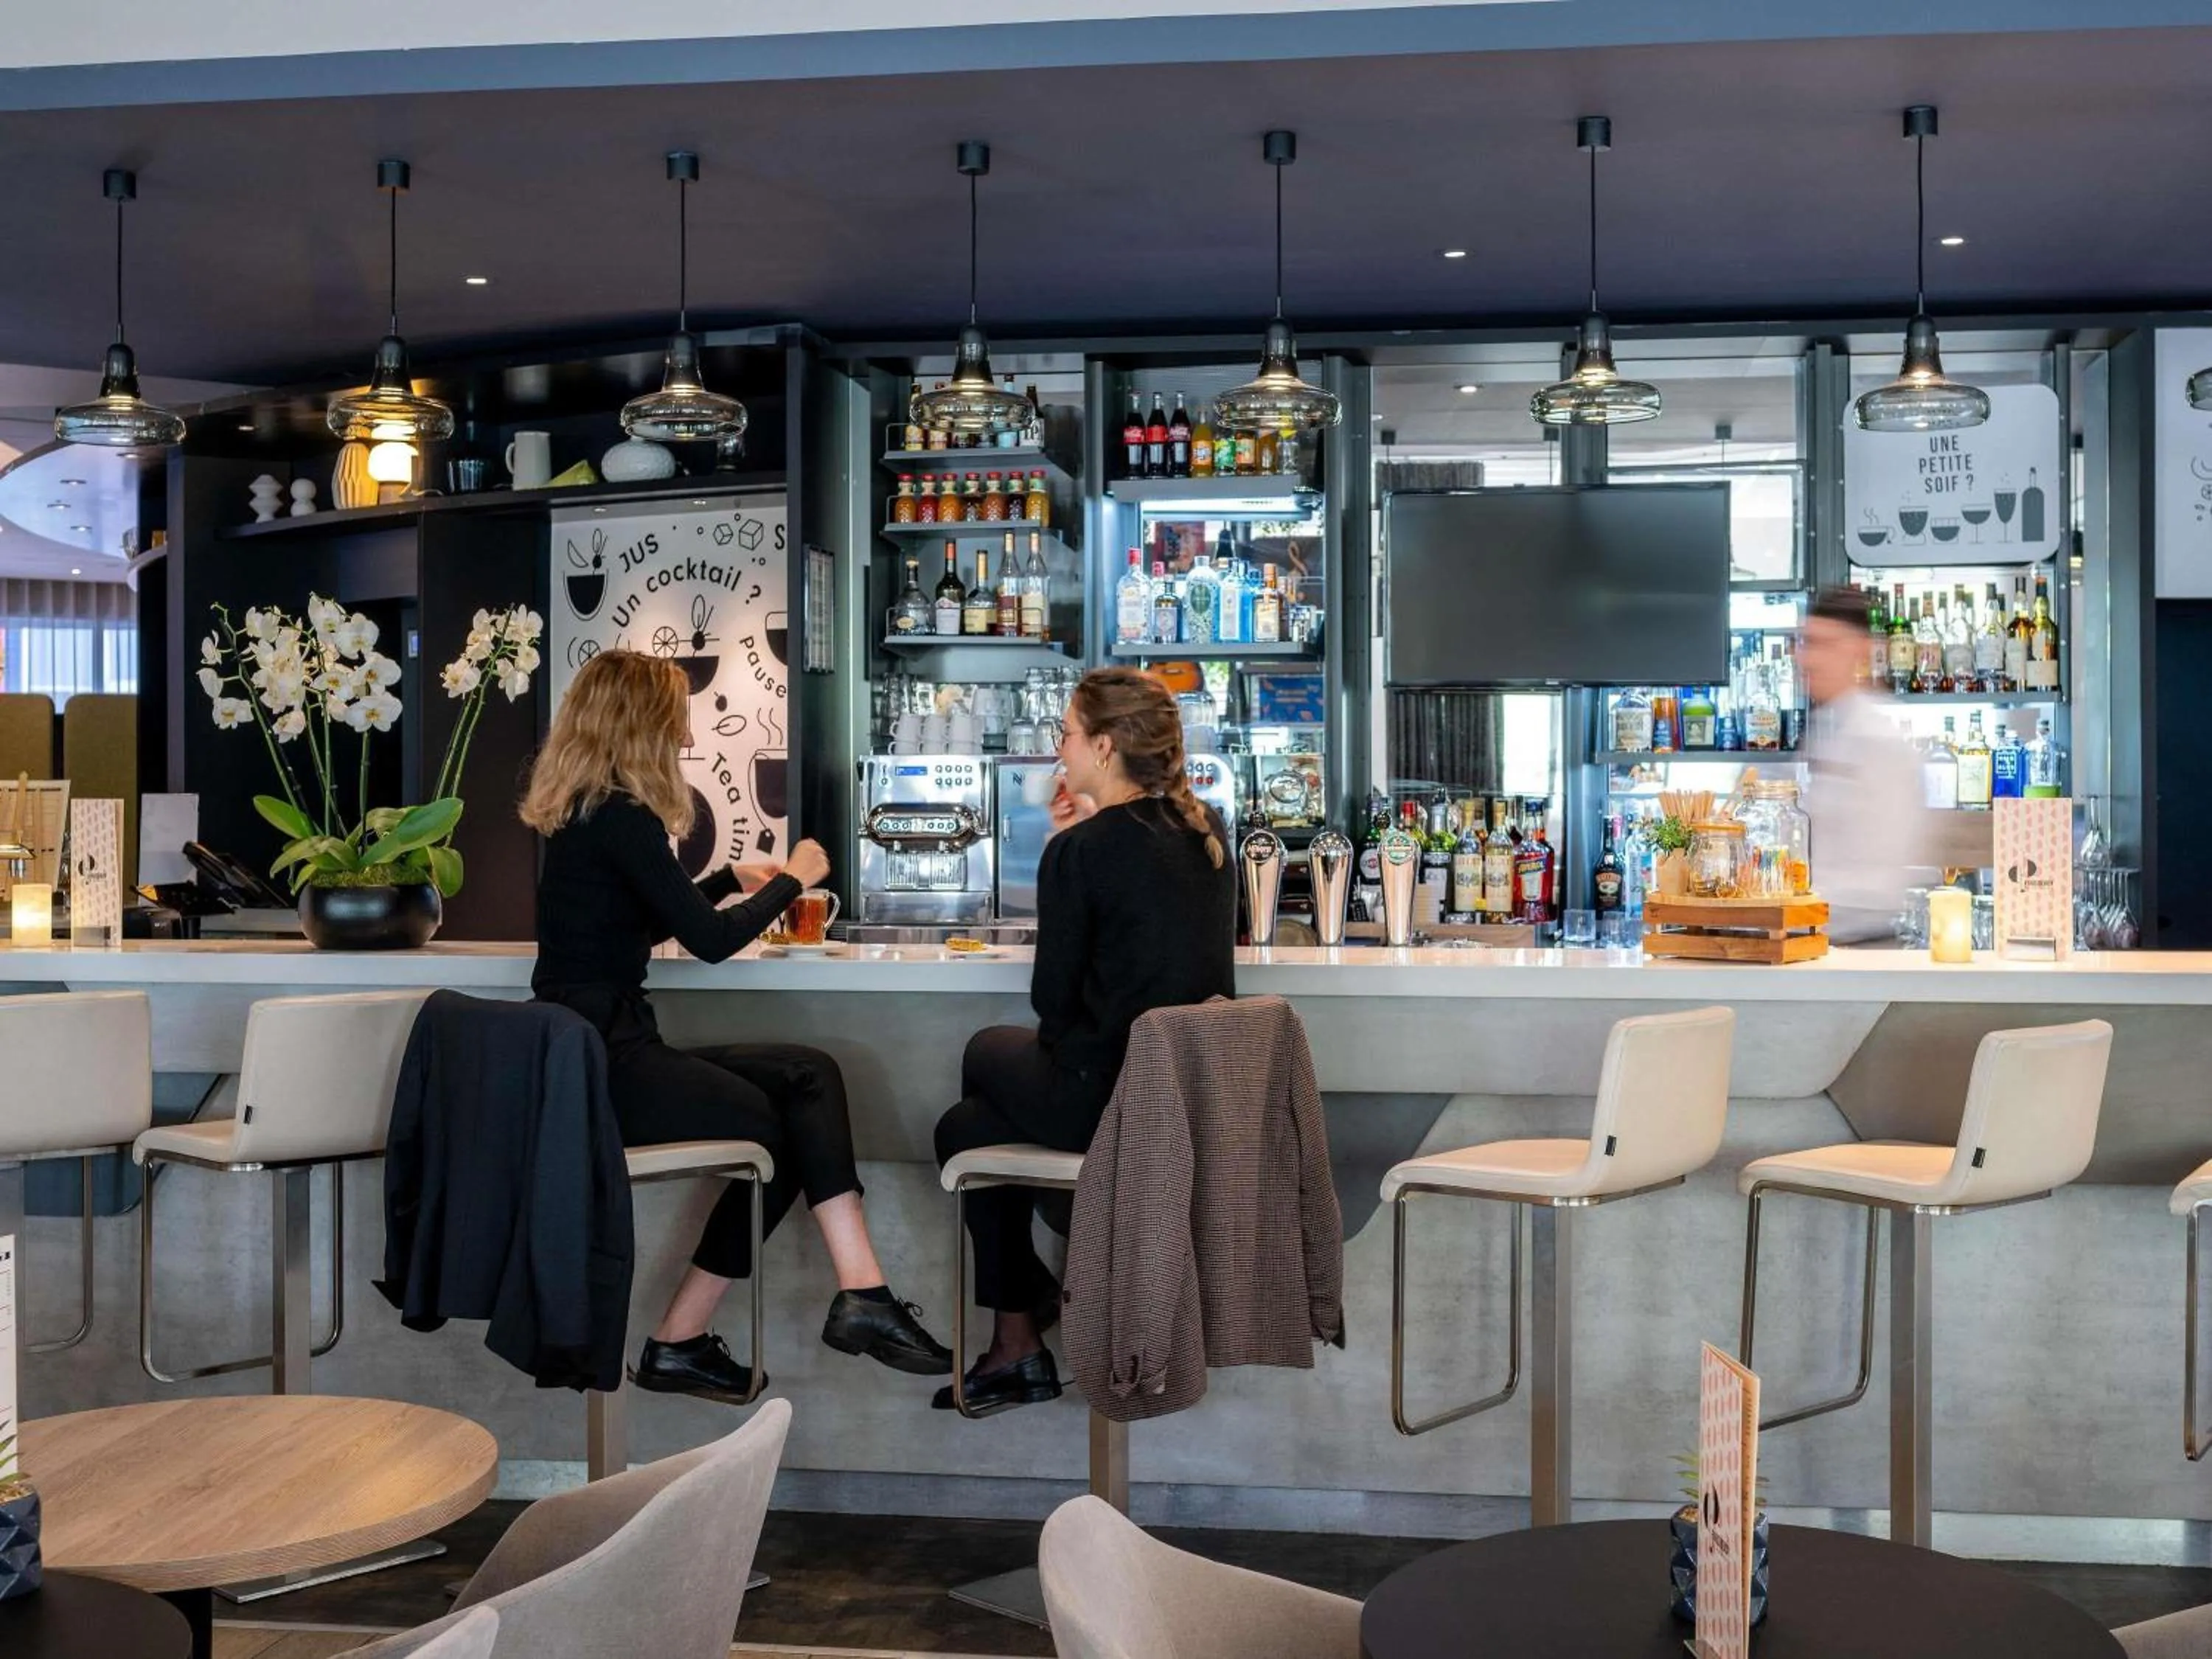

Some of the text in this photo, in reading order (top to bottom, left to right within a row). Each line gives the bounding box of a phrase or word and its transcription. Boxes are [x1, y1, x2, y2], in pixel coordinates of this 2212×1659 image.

[1919, 453, 1972, 474] PETITE
[1930, 434, 1959, 453] UNE
[1924, 473, 1974, 494] SOIF ?
[619, 533, 658, 573] JUS
[612, 593, 641, 628] Un
[646, 557, 742, 594] cocktail
[739, 636, 787, 698] Pause
[712, 751, 750, 861] Tea tim
